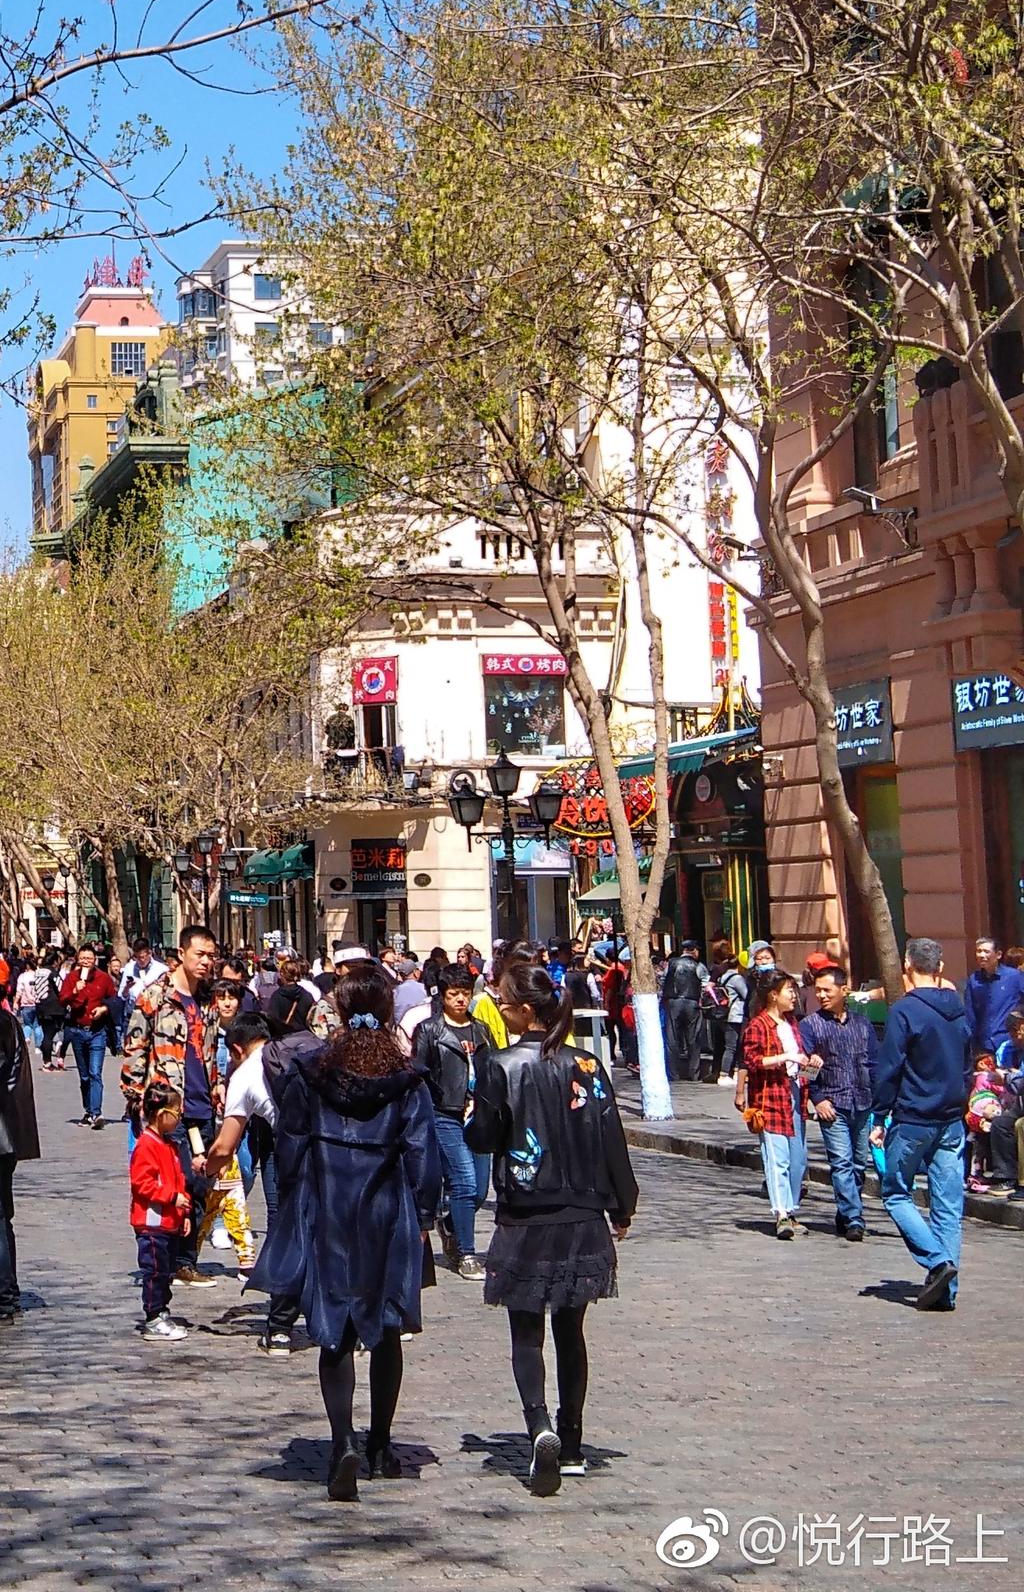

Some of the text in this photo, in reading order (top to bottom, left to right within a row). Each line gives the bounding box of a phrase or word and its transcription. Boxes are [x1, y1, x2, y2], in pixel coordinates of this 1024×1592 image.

[486, 657, 567, 672] 韩式 烤肉
[554, 796, 609, 827] 冷饮
[351, 847, 404, 869] 芭米莉
